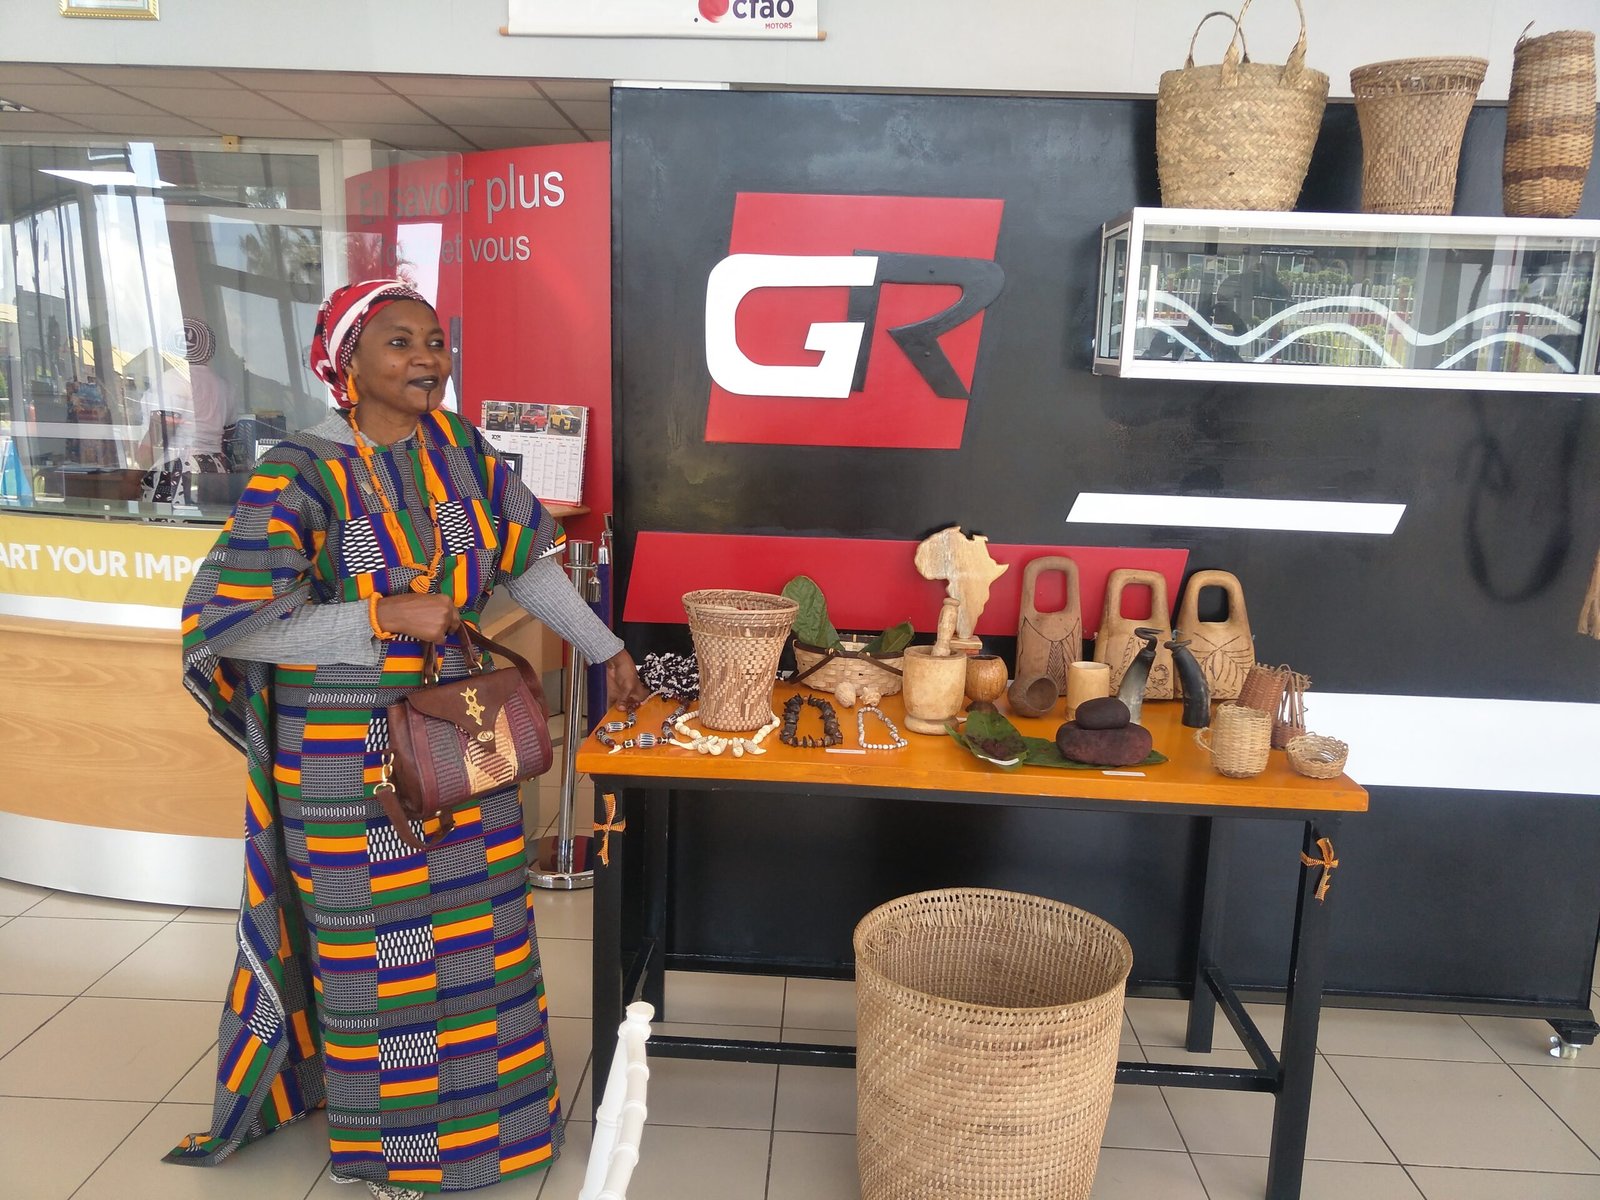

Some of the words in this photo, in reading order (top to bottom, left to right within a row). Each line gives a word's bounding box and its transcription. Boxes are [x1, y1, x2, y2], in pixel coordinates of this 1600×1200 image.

[765, 22, 793, 30] MOTORS
[359, 182, 386, 225] En
[392, 169, 475, 220] savoir
[486, 163, 565, 224] plus
[441, 232, 464, 264] et
[469, 235, 531, 263] vous
[705, 249, 1005, 400] GR
[46, 545, 129, 578] YOUR
